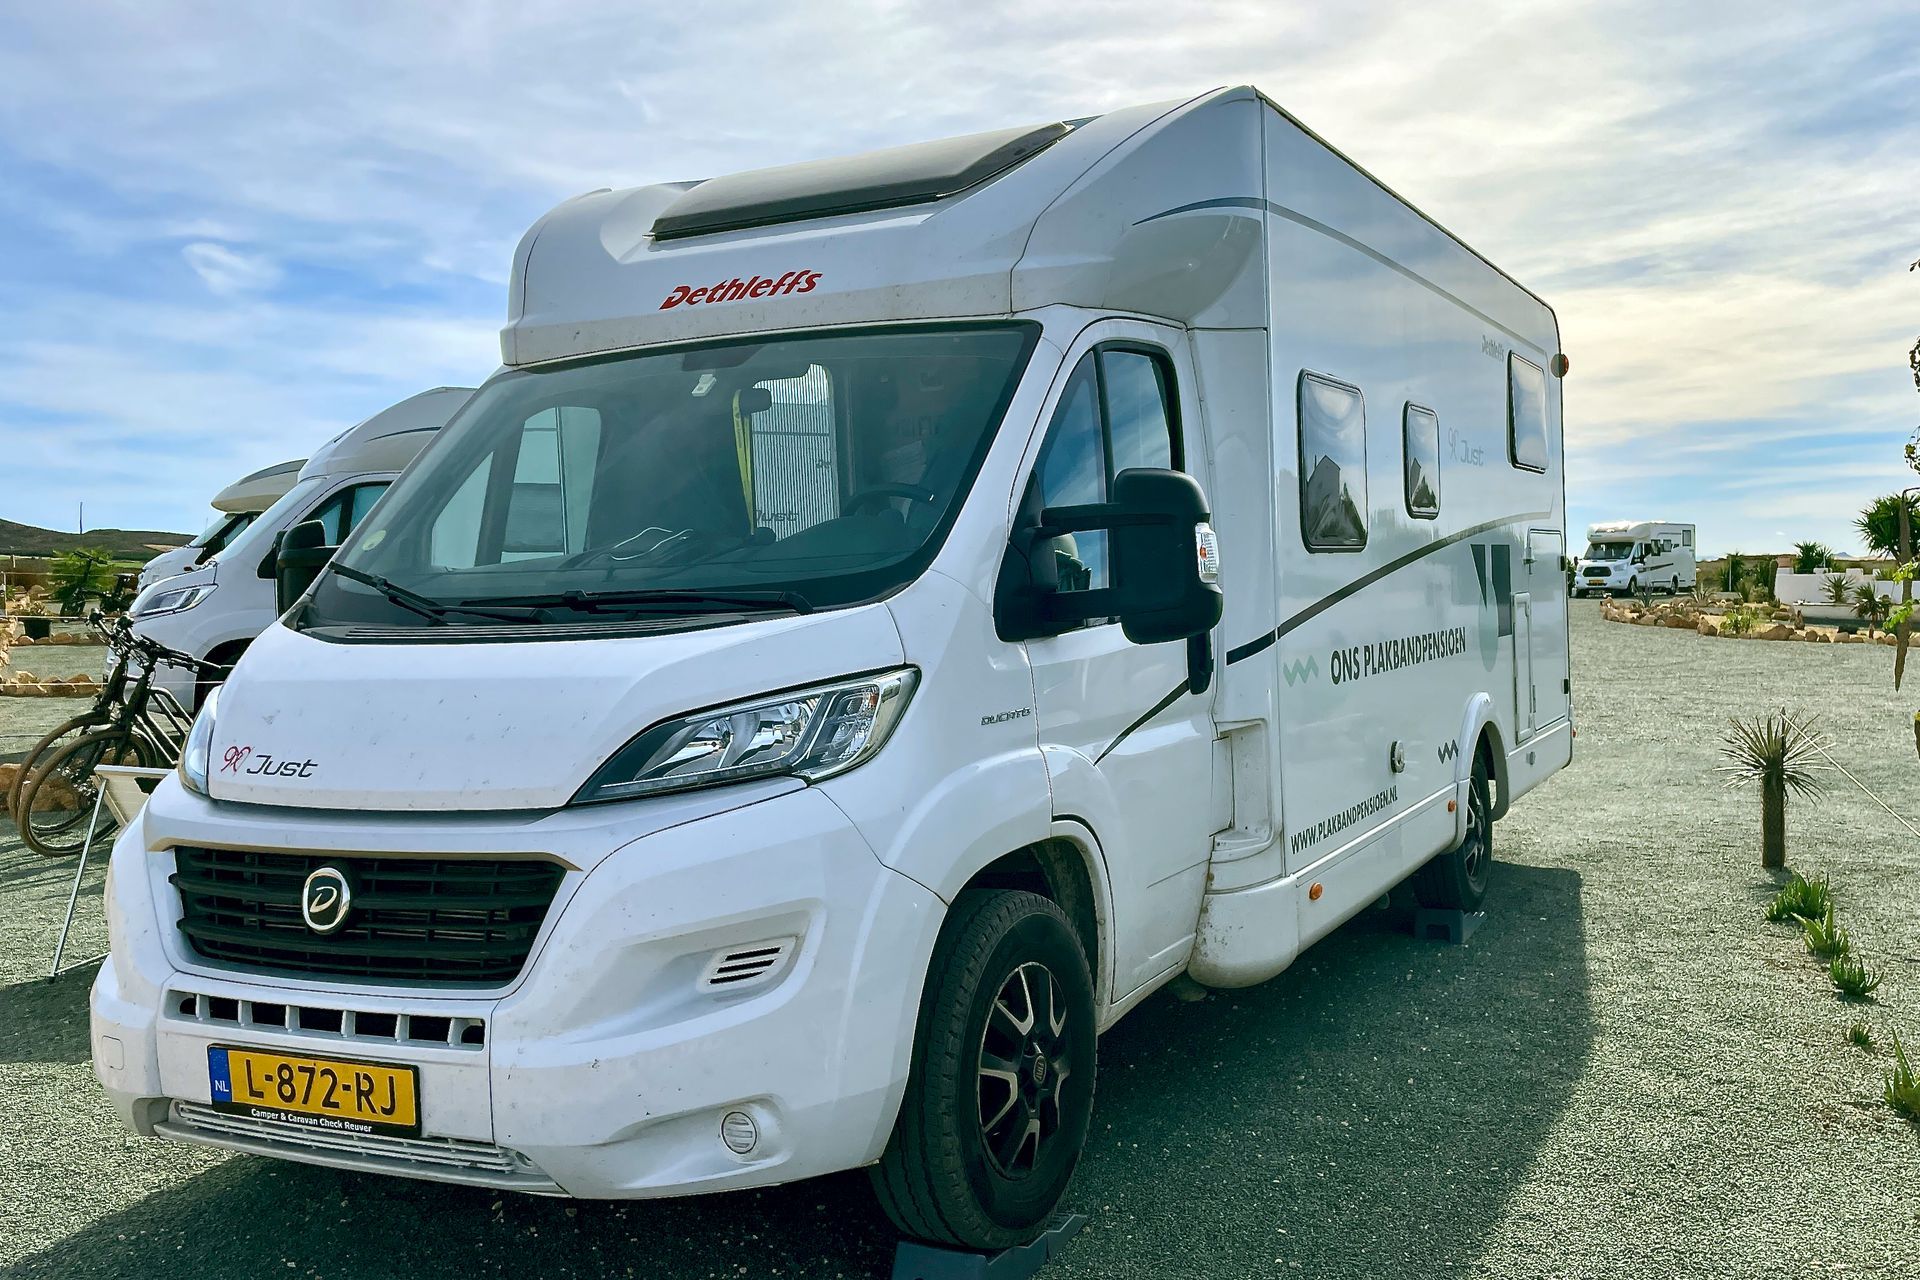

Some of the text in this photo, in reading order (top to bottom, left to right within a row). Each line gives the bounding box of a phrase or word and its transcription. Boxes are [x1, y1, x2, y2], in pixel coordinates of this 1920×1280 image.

[659, 269, 823, 310] Dethleffs
[1460, 440, 1485, 467] Just
[1330, 626, 1466, 685] ONS PLAKBANDPENSIOEN
[246, 754, 319, 777] Just
[1290, 785, 1398, 855] WWW.PLAKBANDPENSIOEN.NL
[215, 1080, 230, 1093] NL
[246, 1059, 396, 1116] L-872-RJ
[251, 1108, 372, 1133] Camper & Caravan Check Reuver
